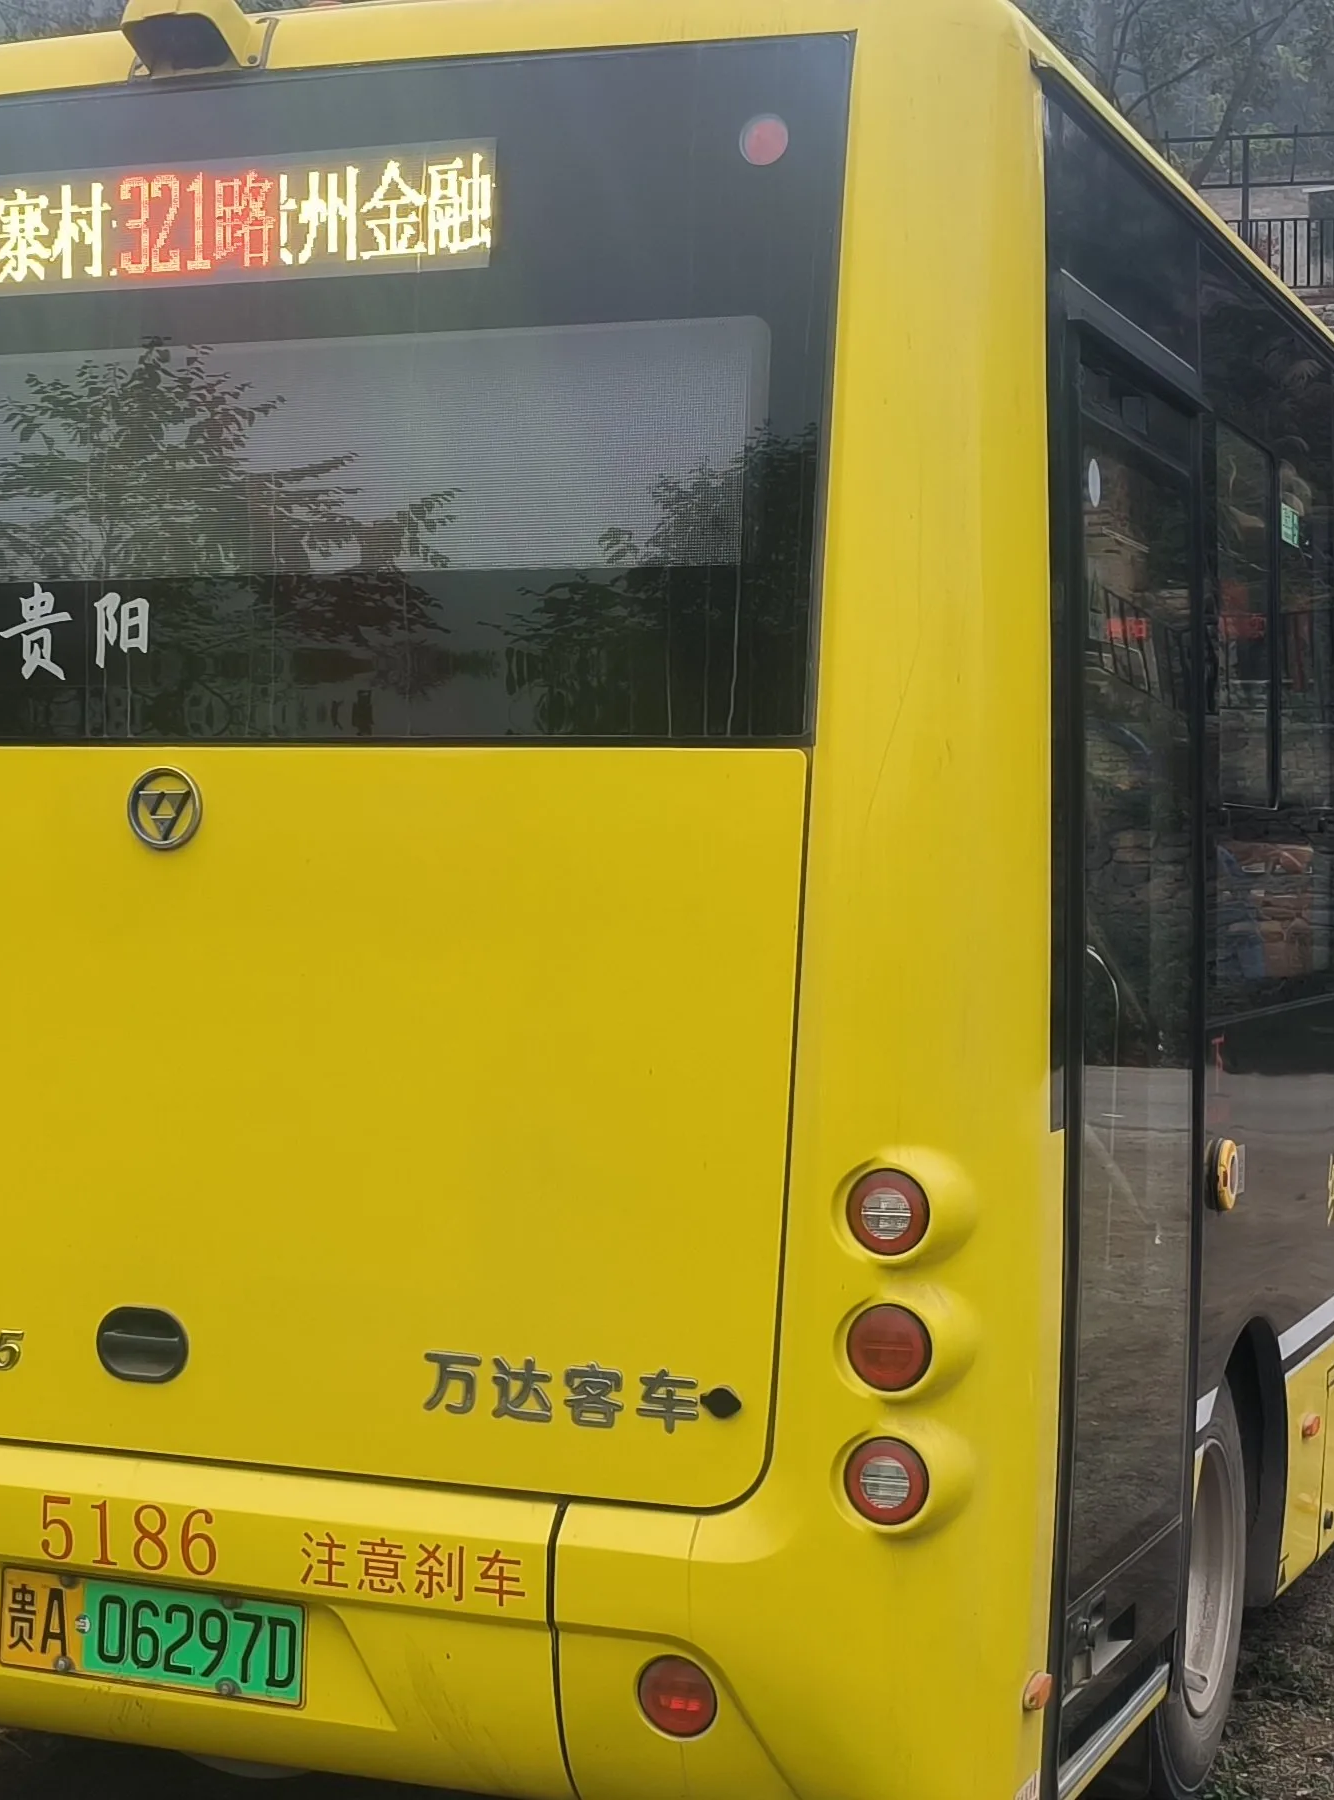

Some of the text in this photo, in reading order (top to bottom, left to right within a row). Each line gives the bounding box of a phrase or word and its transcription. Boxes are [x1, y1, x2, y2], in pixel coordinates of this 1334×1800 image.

[120, 169, 275, 274] 321路
[280, 153, 494, 265] 州金融
[424, 1350, 699, 1435] 万达客车
[41, 1494, 218, 1576] 5186
[299, 1530, 527, 1607] 注意刹车
